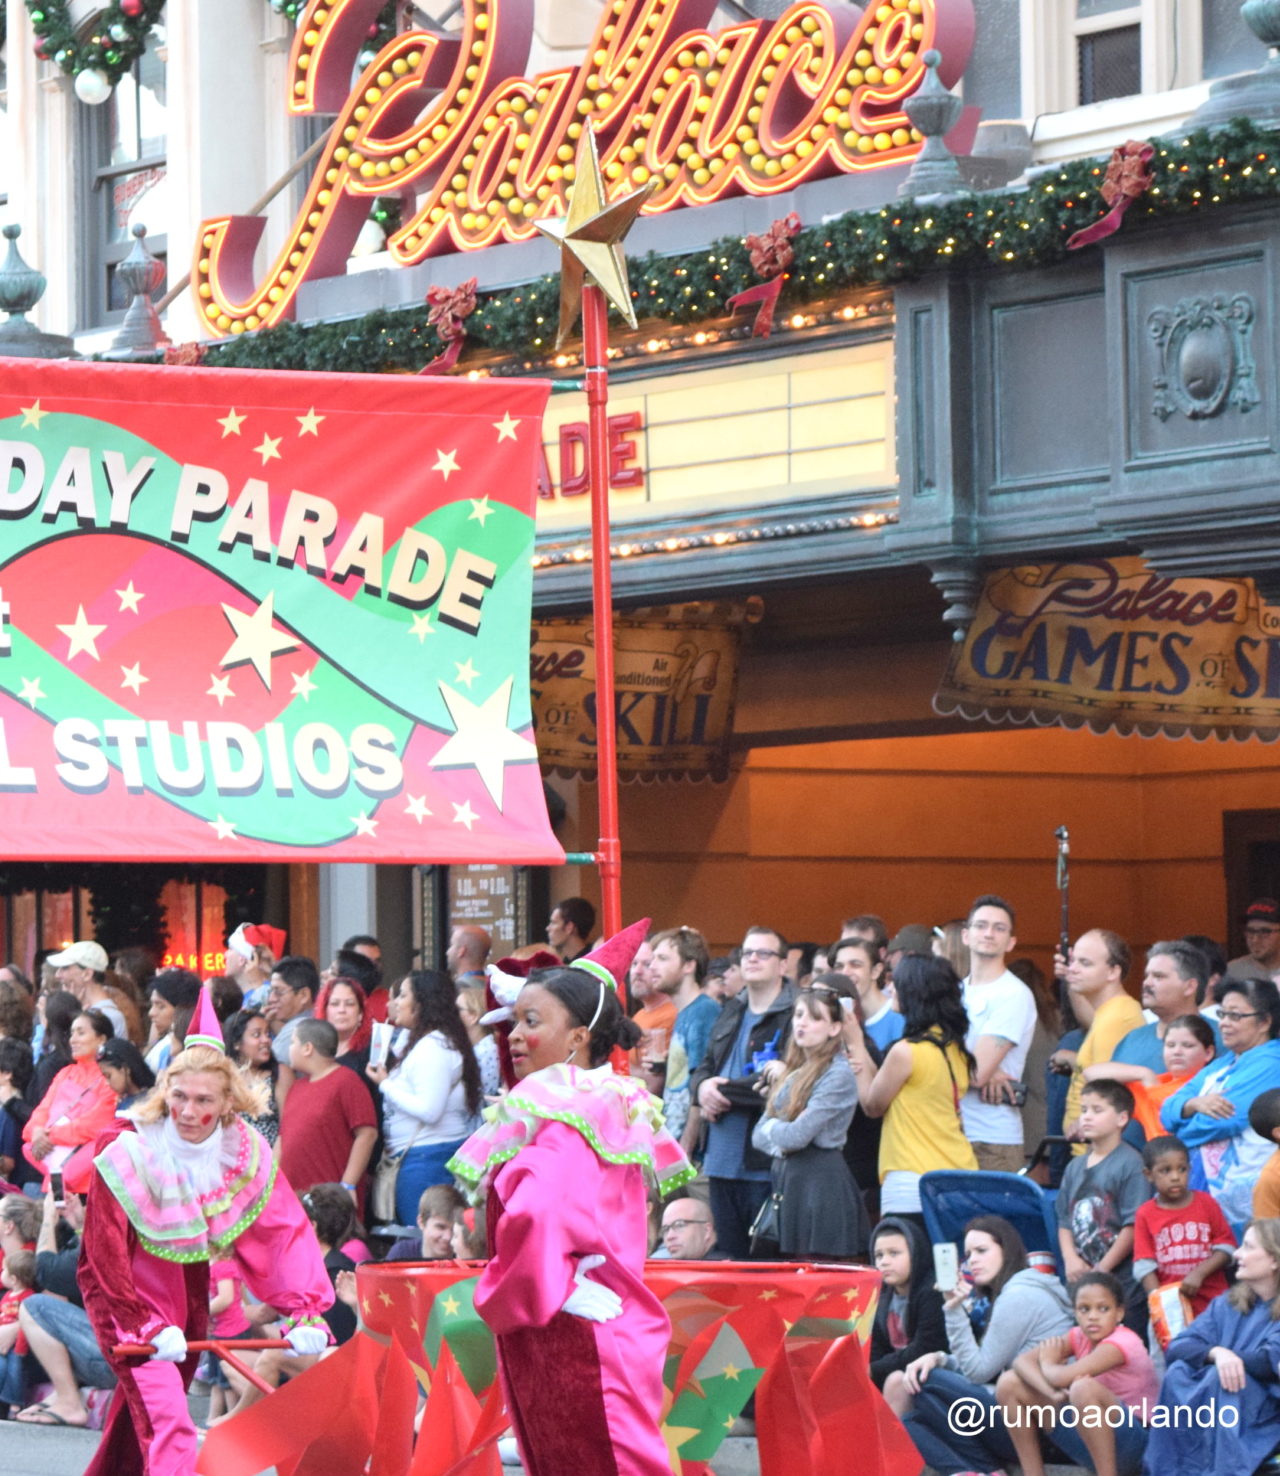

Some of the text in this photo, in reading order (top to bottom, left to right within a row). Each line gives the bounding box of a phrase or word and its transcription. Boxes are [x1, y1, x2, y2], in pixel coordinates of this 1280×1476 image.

[191, 0, 960, 338] Palace
[171, 463, 497, 635] PARADE
[996, 559, 1239, 637] Palace
[652, 658, 669, 671] Air
[971, 622, 1193, 696] GAMES
[1200, 658, 1230, 679] OF
[545, 707, 577, 726] OF
[53, 717, 404, 798] STUDIOS
